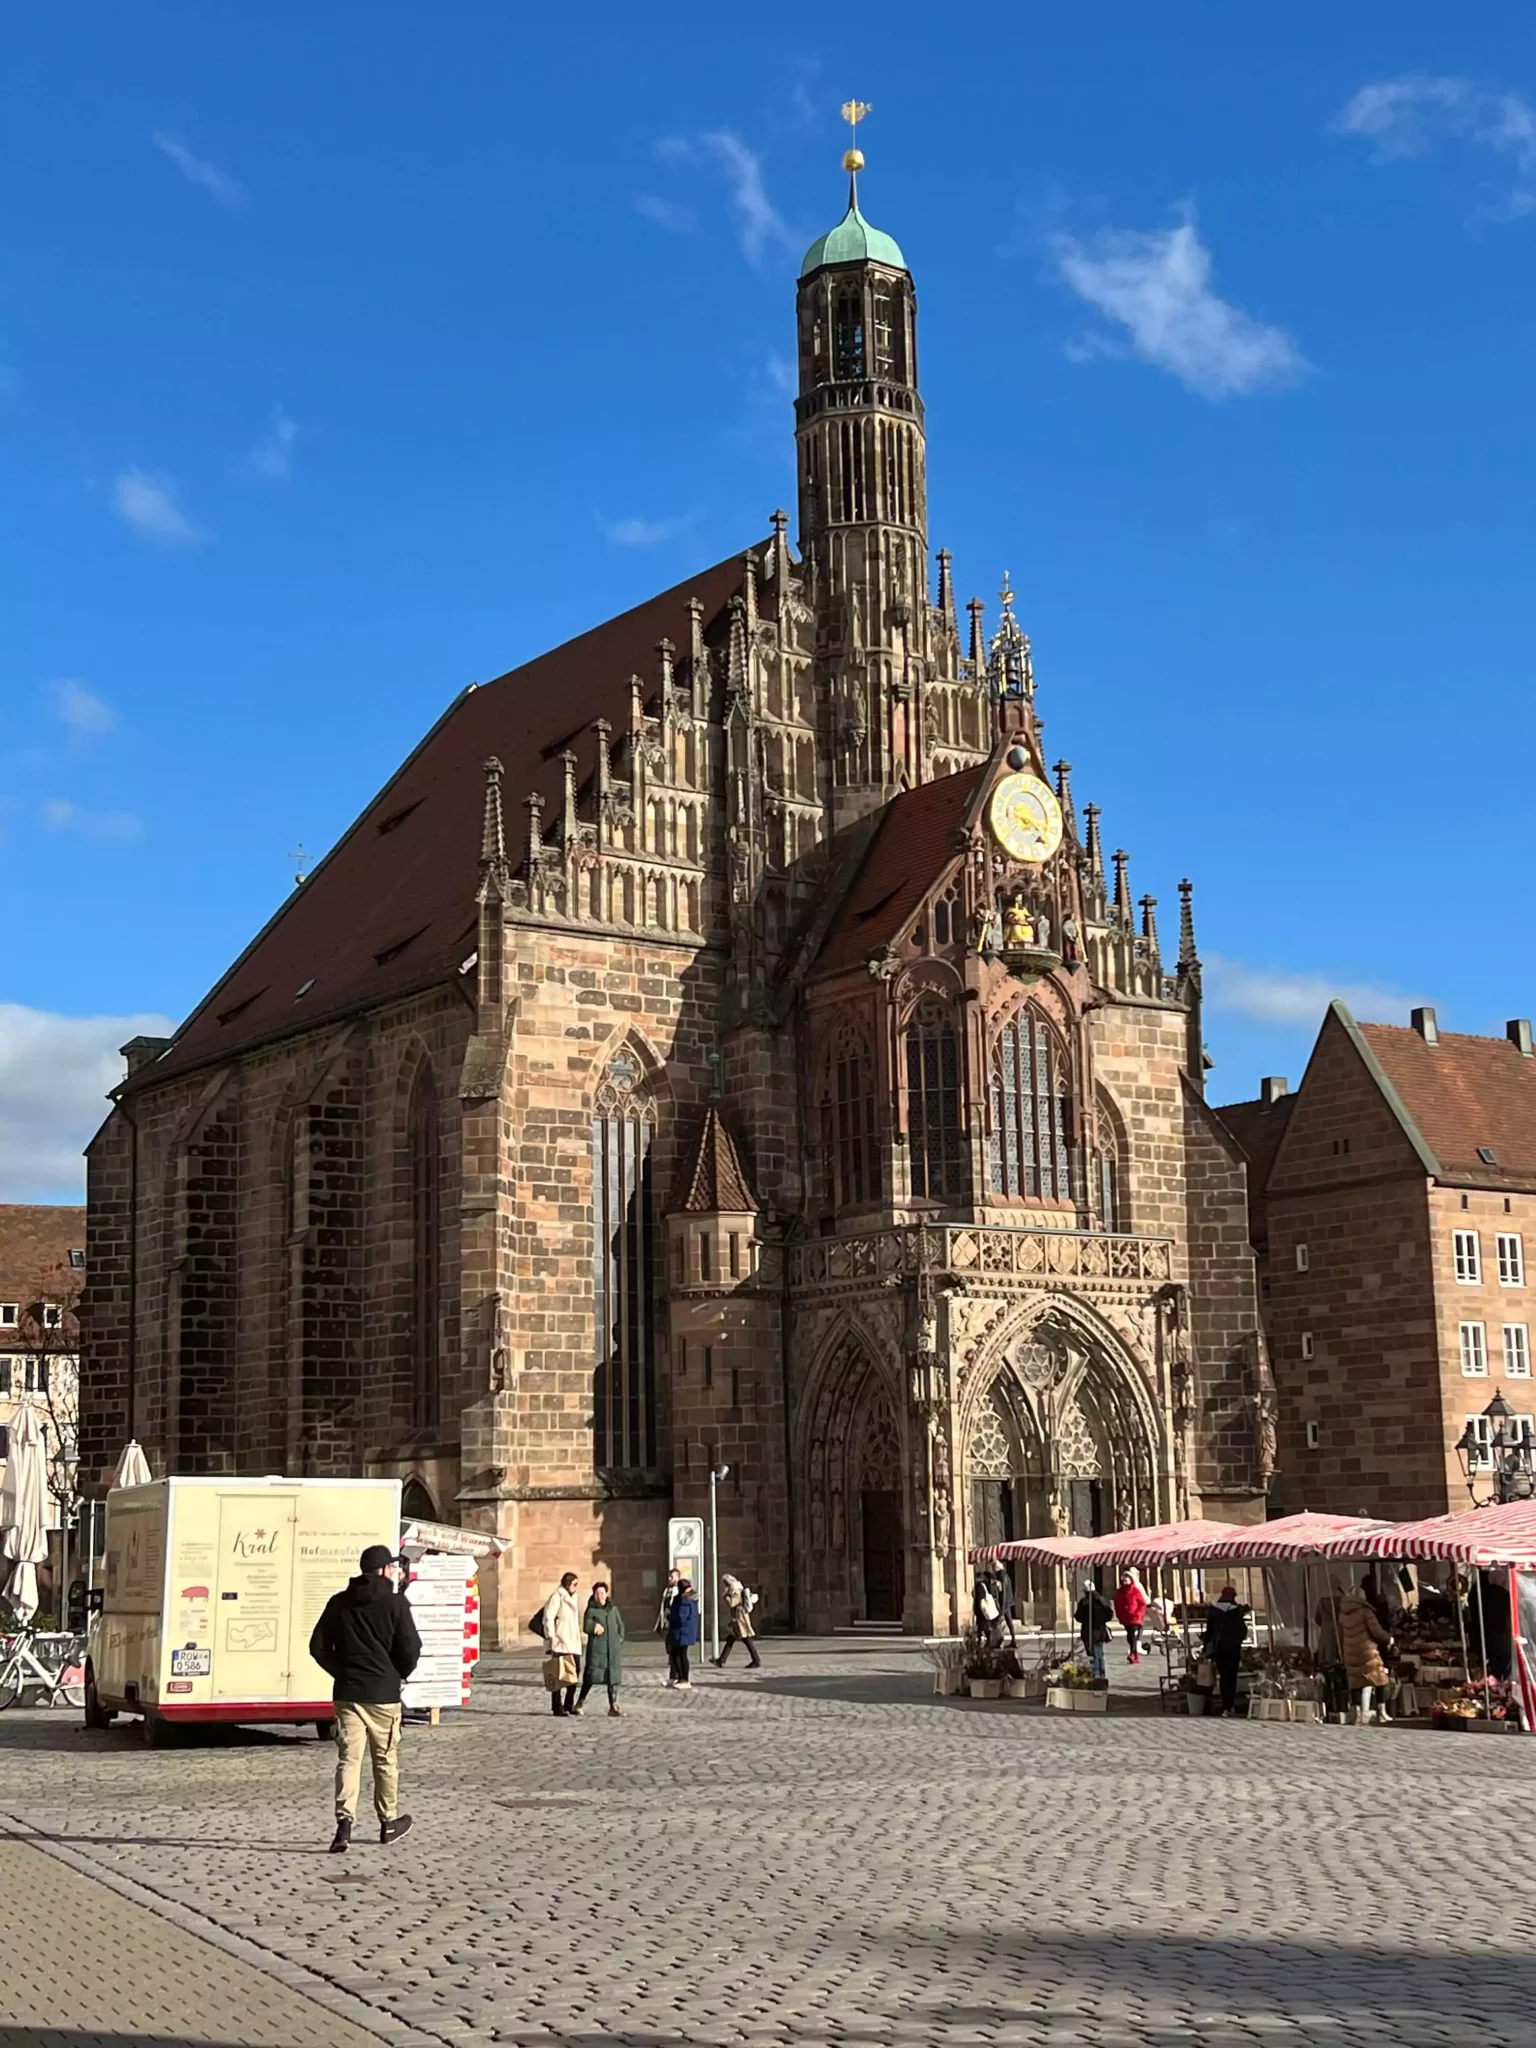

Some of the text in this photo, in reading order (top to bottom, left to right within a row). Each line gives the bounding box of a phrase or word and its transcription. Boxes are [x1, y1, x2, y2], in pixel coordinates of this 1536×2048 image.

[232, 1529, 279, 1558] Kral
[300, 1545, 362, 1556] Hofmanufak
[180, 1651, 198, 1661] ROW
[184, 1661, 201, 1671] 586
